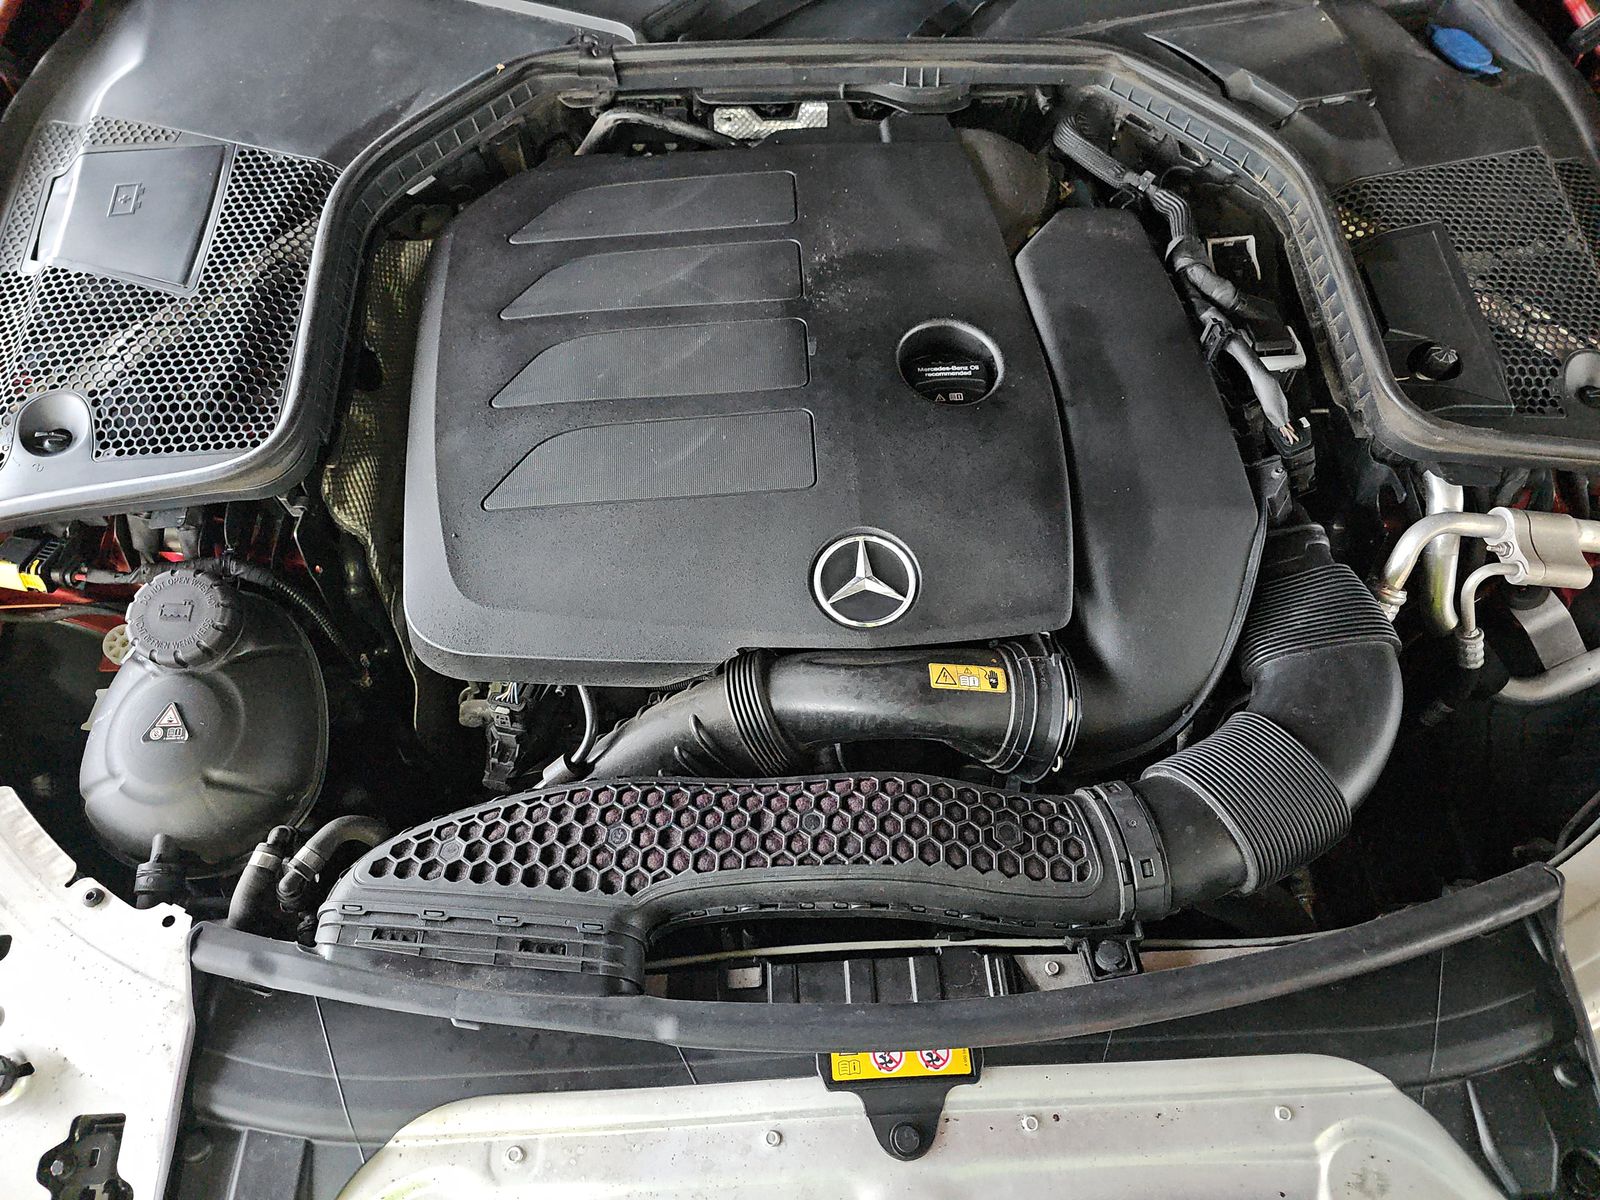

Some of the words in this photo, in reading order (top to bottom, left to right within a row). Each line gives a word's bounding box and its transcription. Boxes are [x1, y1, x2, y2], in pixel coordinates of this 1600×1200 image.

[151, 582, 165, 595] NOT
[167, 576, 190, 585] OPEN
[190, 578, 212, 596] WHEN
[172, 636, 195, 649] WENN
[195, 617, 214, 639] HEISS
